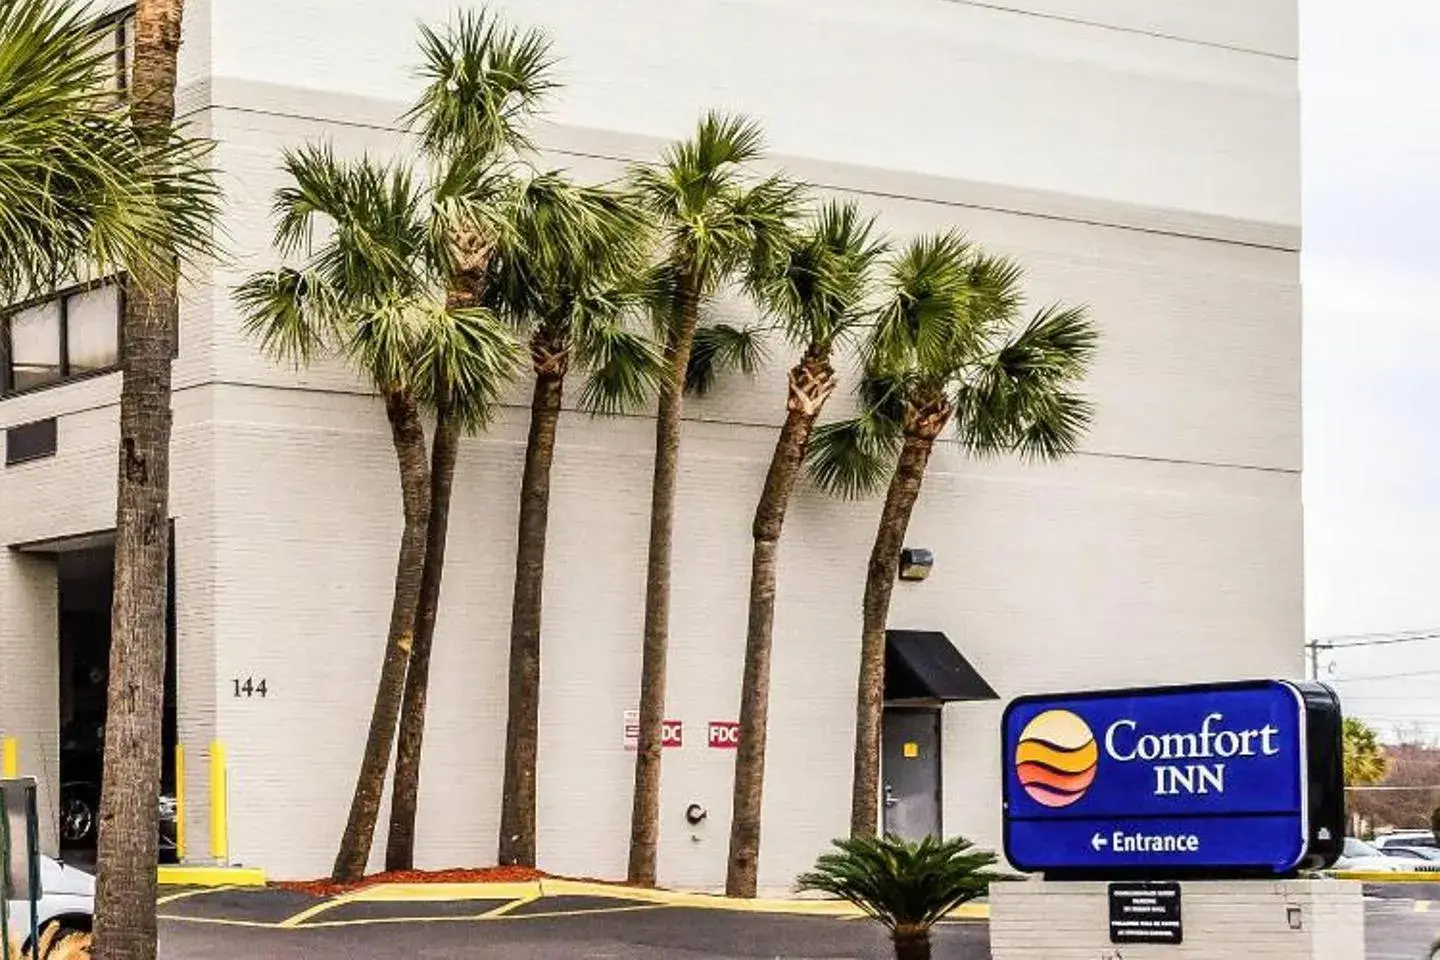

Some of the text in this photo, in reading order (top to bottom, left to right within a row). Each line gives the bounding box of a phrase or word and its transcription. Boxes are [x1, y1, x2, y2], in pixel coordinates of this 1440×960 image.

[231, 676, 268, 698] 144
[661, 724, 681, 742] DC
[709, 726, 739, 744] FDC
[1105, 712, 1280, 761] Comfort
[1153, 763, 1226, 795] INN
[1112, 831, 1200, 853] Entrance
